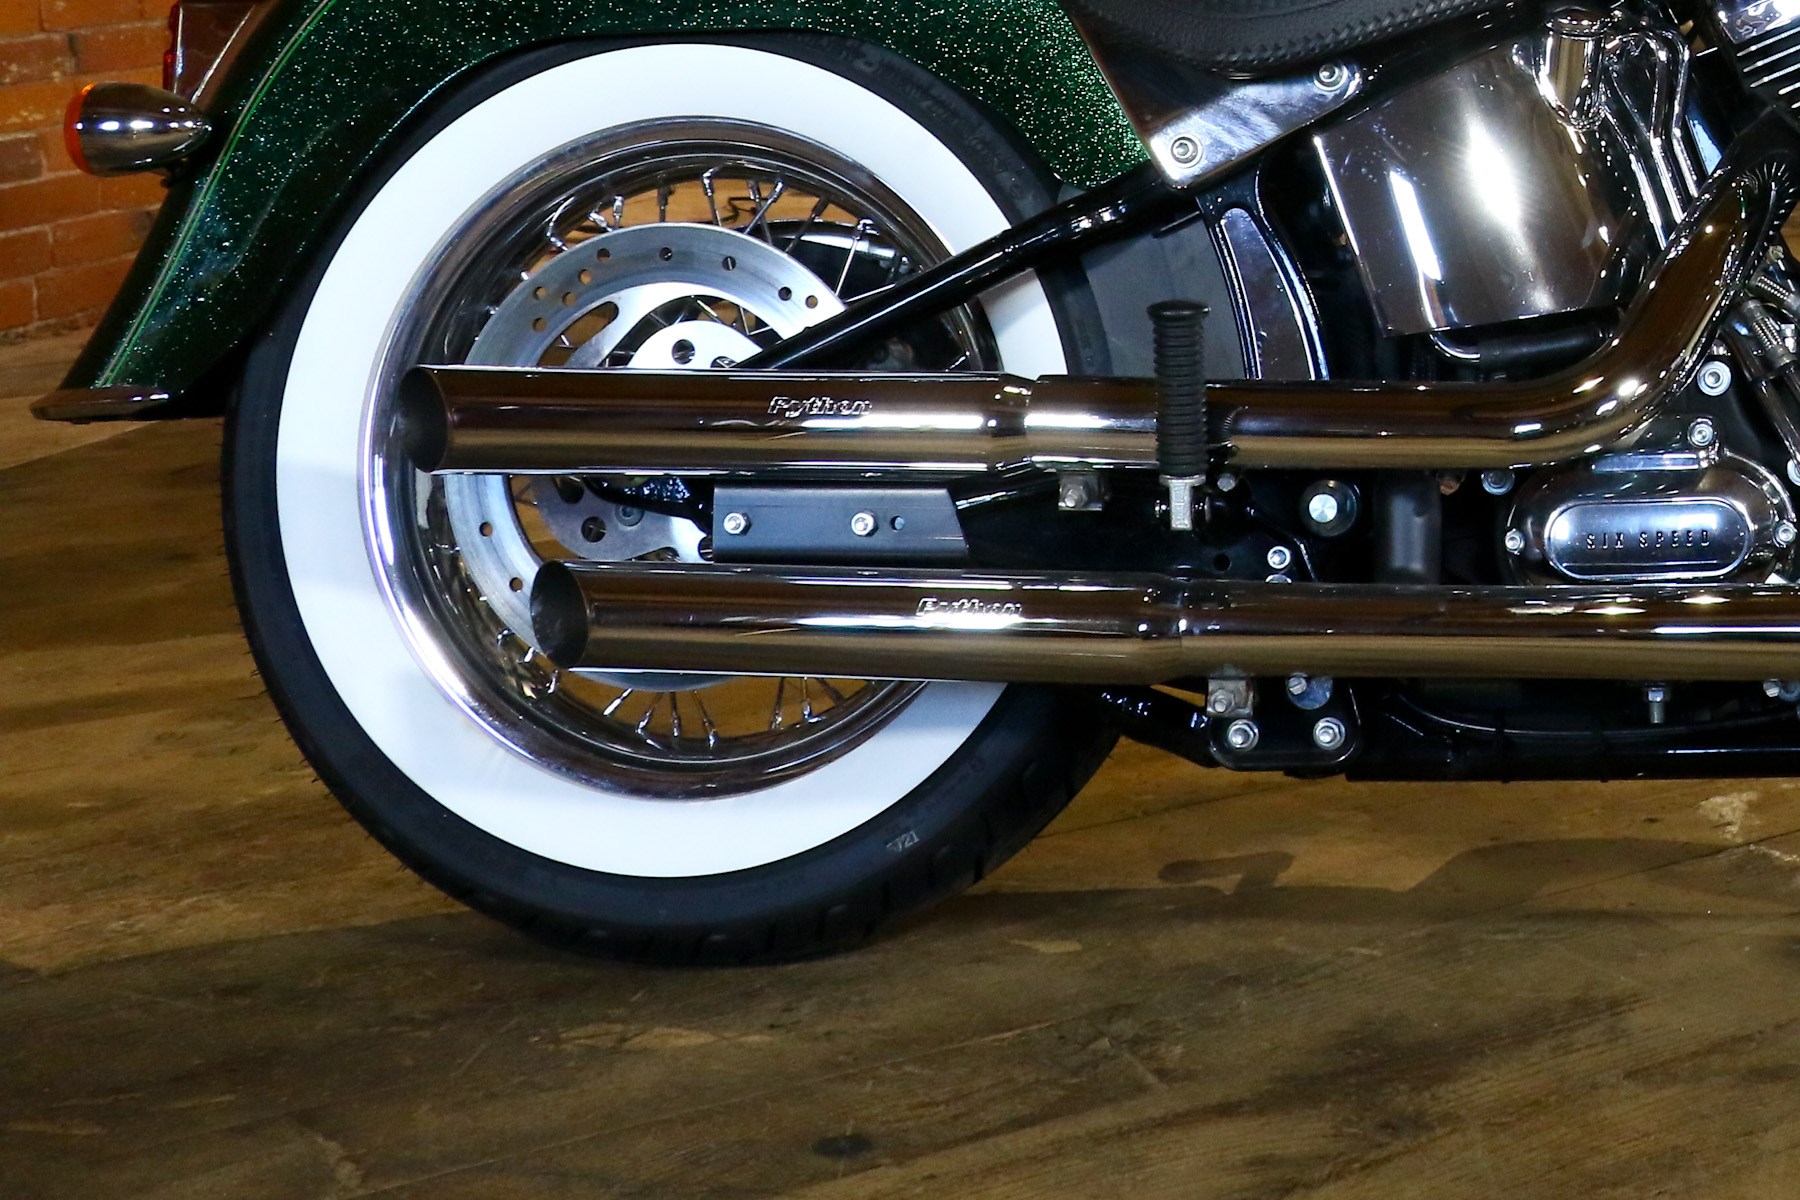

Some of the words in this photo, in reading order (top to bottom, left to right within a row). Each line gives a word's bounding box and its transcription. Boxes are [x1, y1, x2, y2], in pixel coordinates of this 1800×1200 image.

[767, 396, 873, 418] Python
[1585, 532, 1624, 549] SIX
[1638, 530, 1710, 548] SPEED
